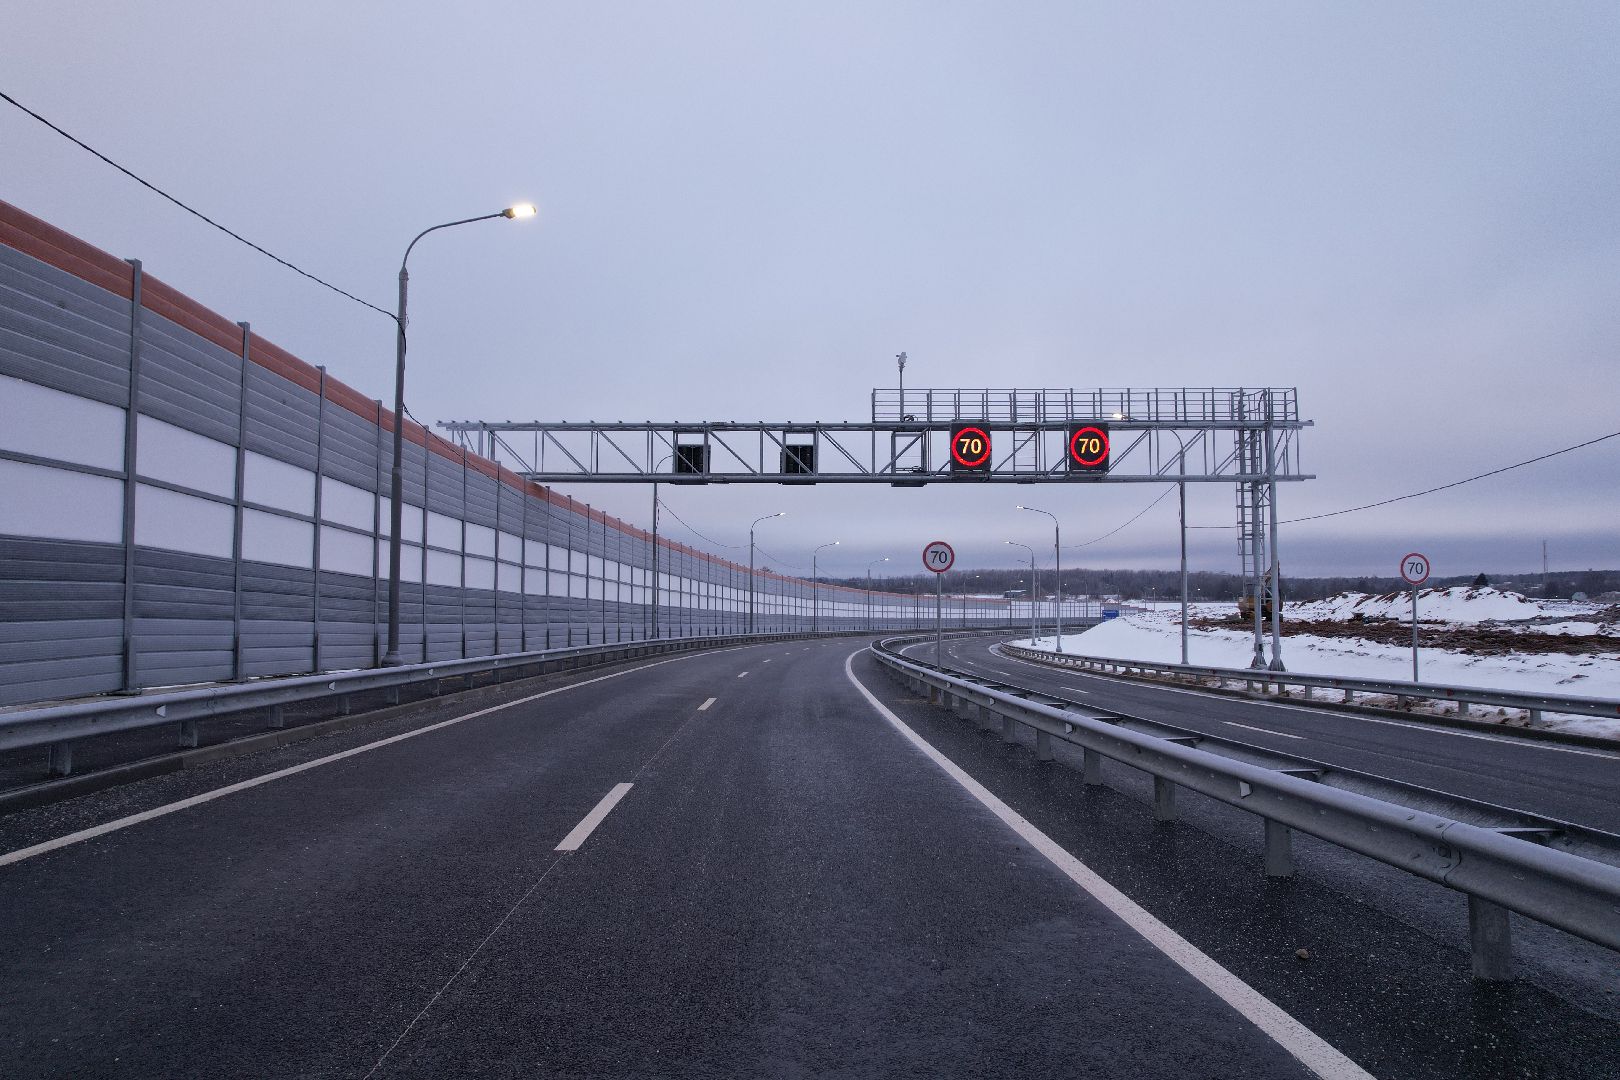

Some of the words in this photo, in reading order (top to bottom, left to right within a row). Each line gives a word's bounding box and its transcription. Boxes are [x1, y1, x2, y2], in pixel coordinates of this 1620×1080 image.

[960, 438, 982, 454] 70
[1079, 438, 1100, 454] 70
[931, 551, 947, 563] 70
[1408, 562, 1423, 574] 70
